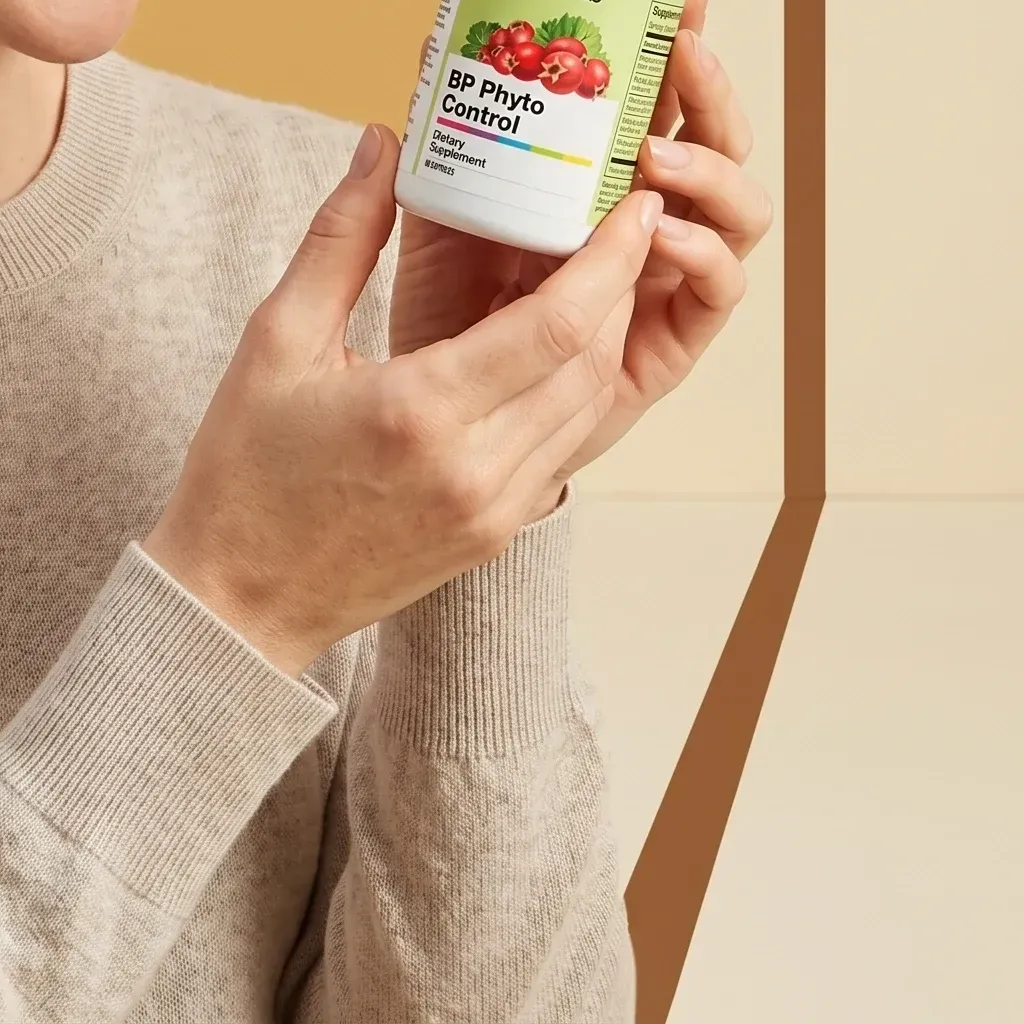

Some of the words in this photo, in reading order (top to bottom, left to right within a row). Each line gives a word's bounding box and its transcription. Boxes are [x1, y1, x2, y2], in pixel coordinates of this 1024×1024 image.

[447, 69, 476, 92] BP
[479, 79, 545, 115] Phyto
[442, 93, 521, 134] Control
[429, 141, 487, 169] Supplement
[432, 129, 466, 151] Dietary
